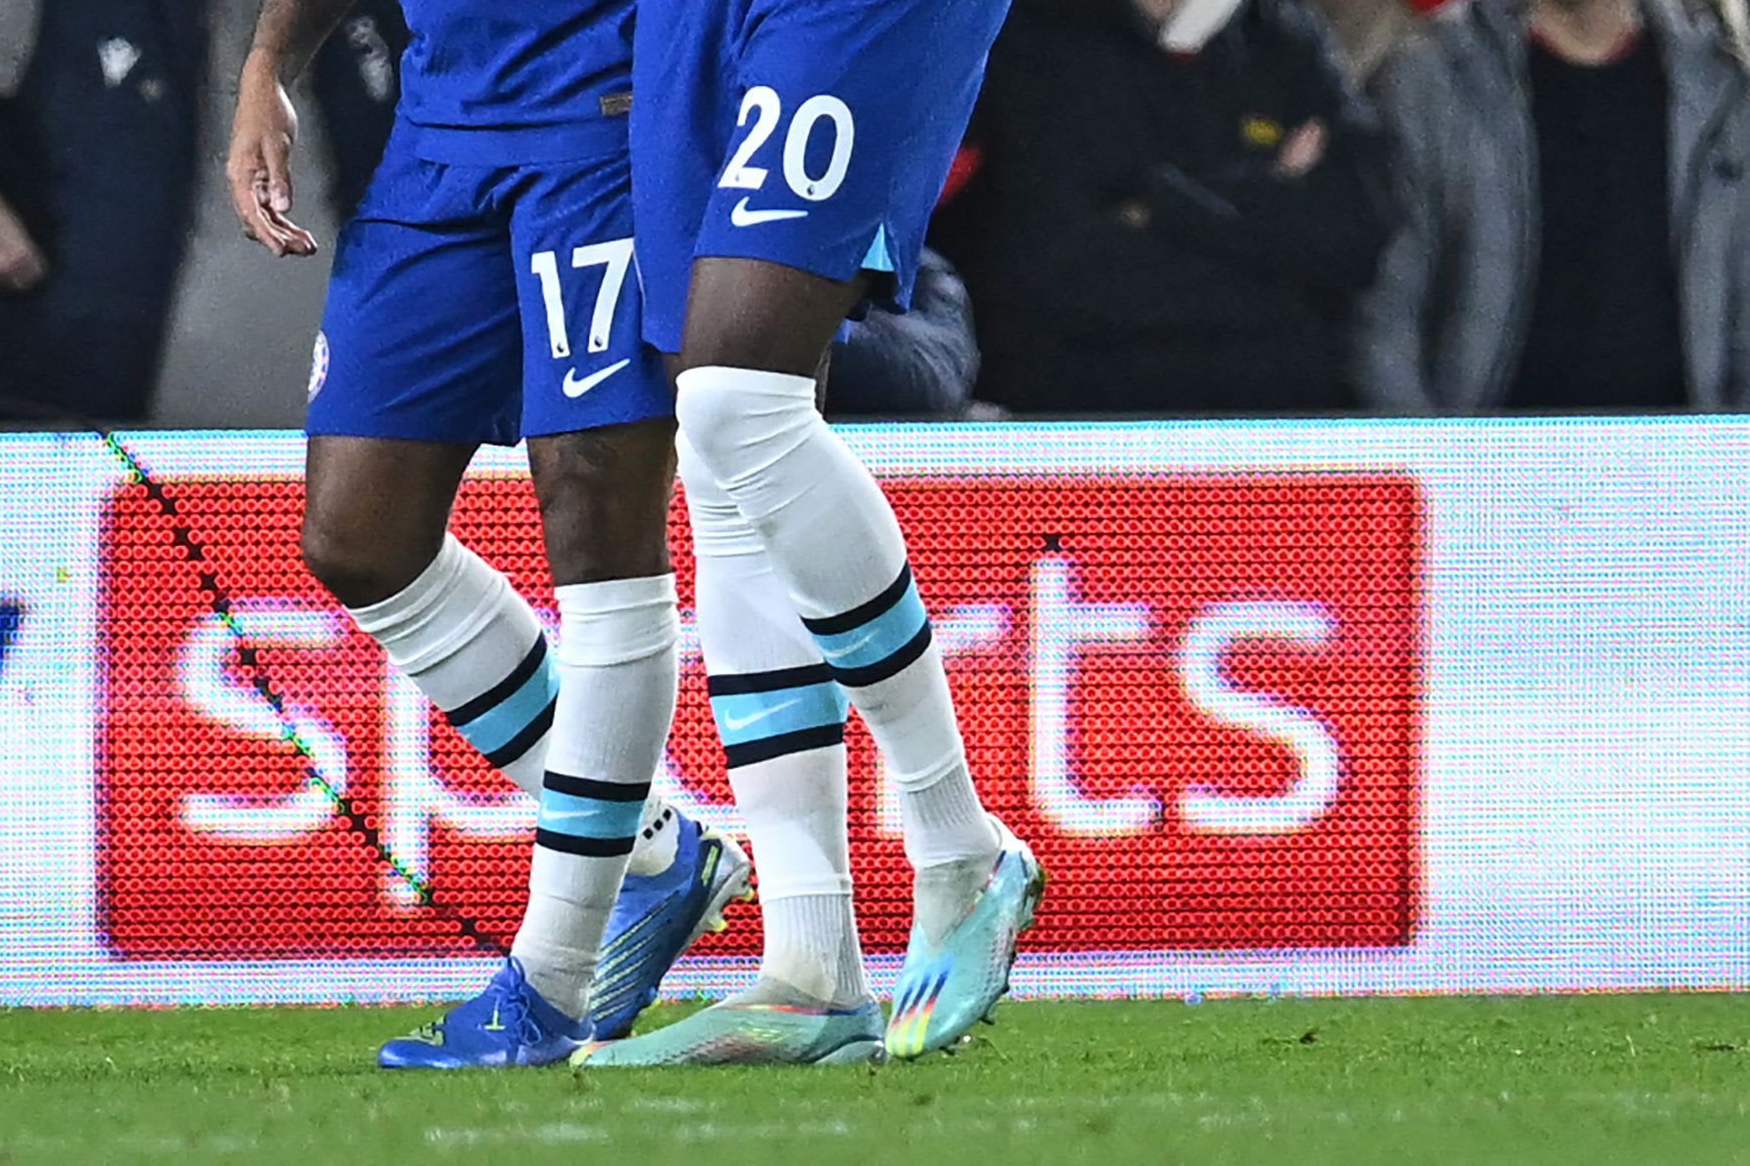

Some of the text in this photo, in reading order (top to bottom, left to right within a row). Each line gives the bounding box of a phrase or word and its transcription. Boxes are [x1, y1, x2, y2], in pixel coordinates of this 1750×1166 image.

[717, 85, 855, 202] 20
[531, 238, 635, 360] 17
[175, 554, 1346, 914] spts
